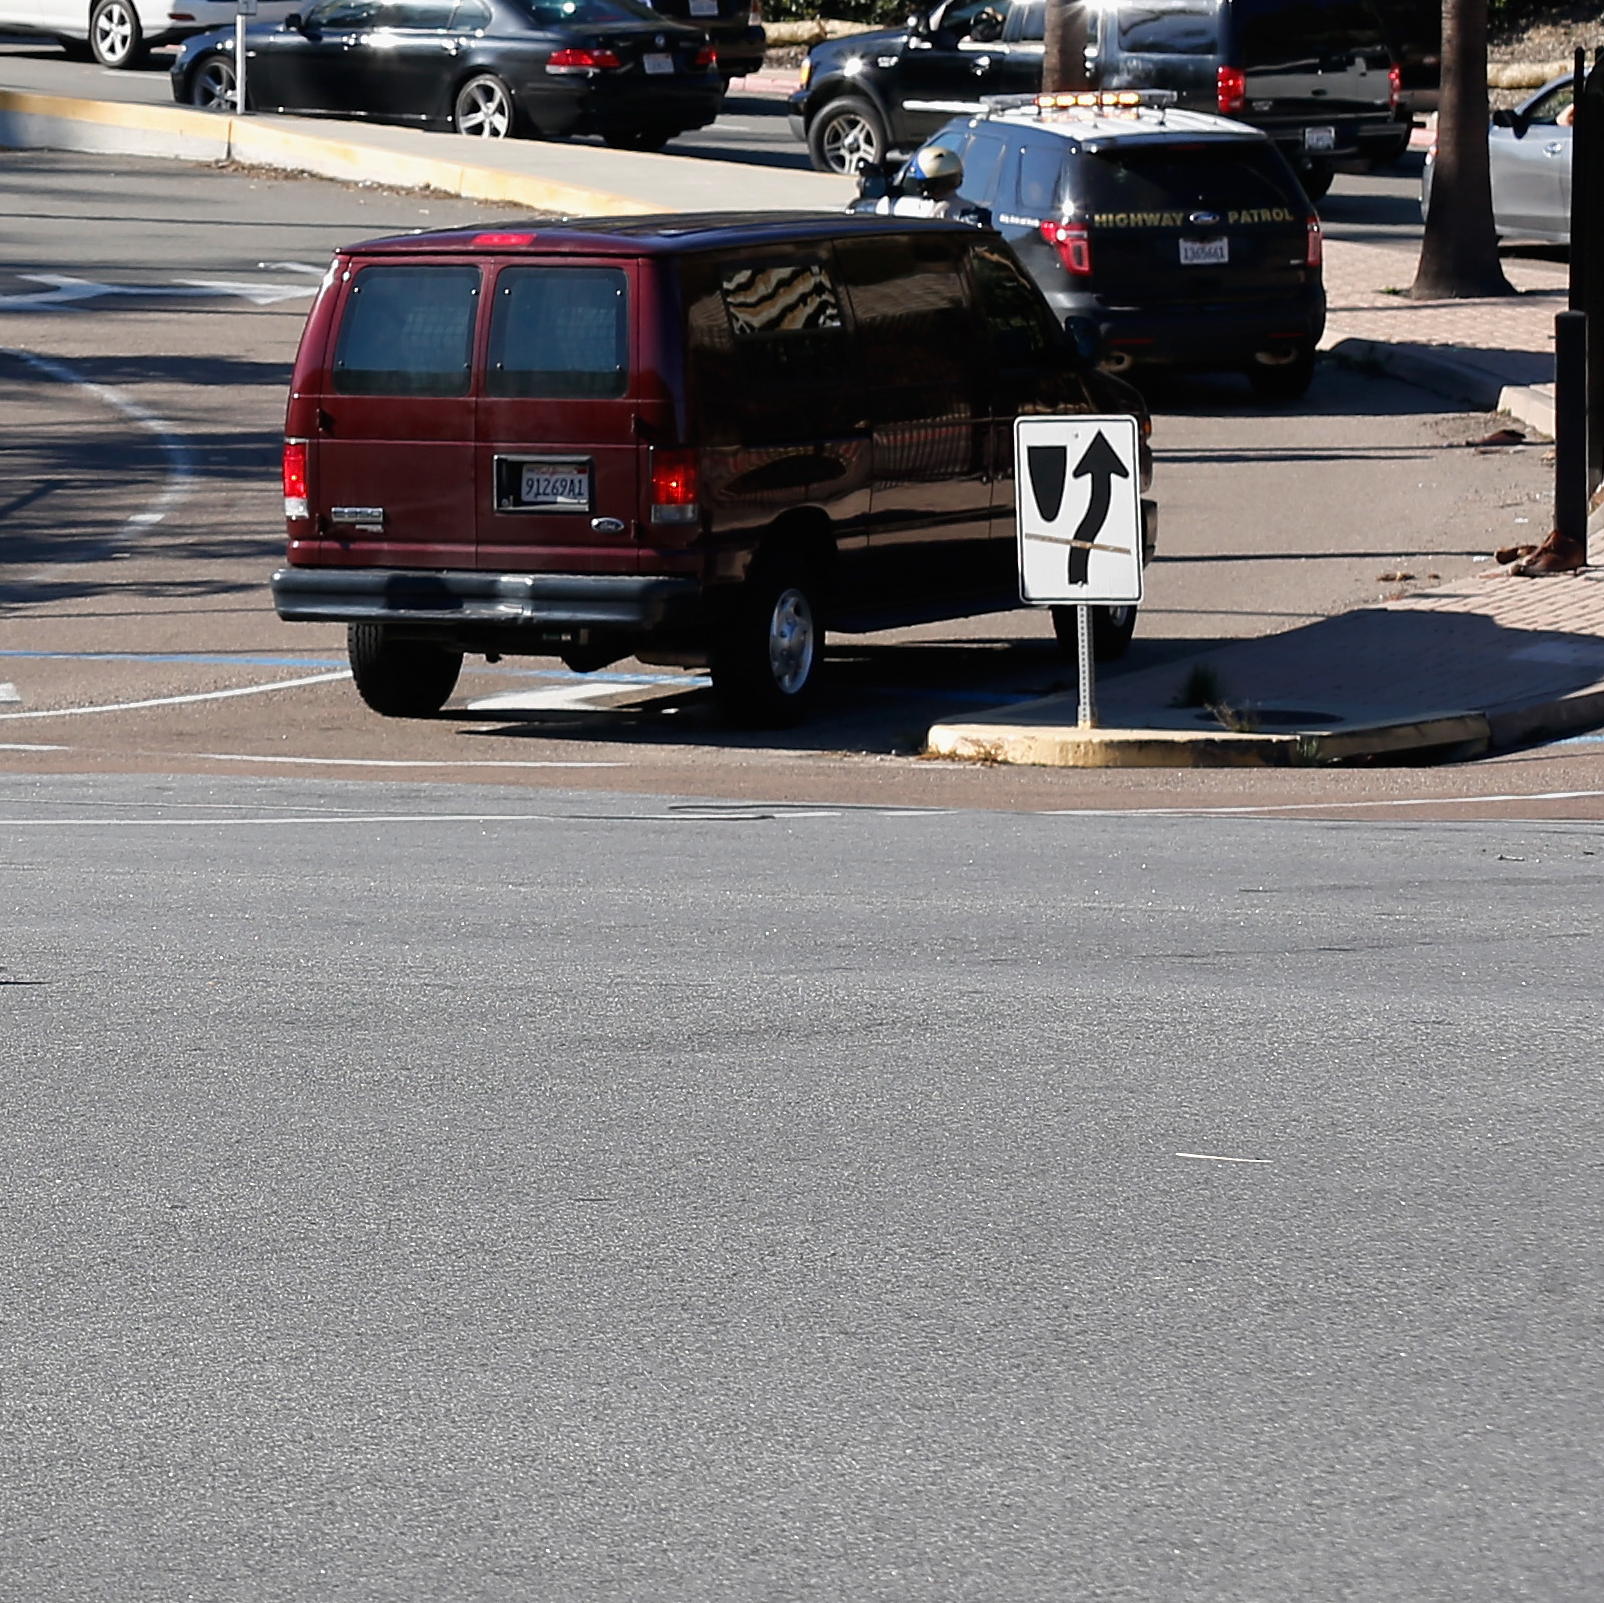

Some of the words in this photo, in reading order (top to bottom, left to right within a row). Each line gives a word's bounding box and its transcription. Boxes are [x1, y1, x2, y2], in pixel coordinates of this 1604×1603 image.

[1094, 212, 1185, 228] HIGHWAY
[1227, 208, 1294, 225] PATROL
[525, 477, 585, 497] 91269A1
